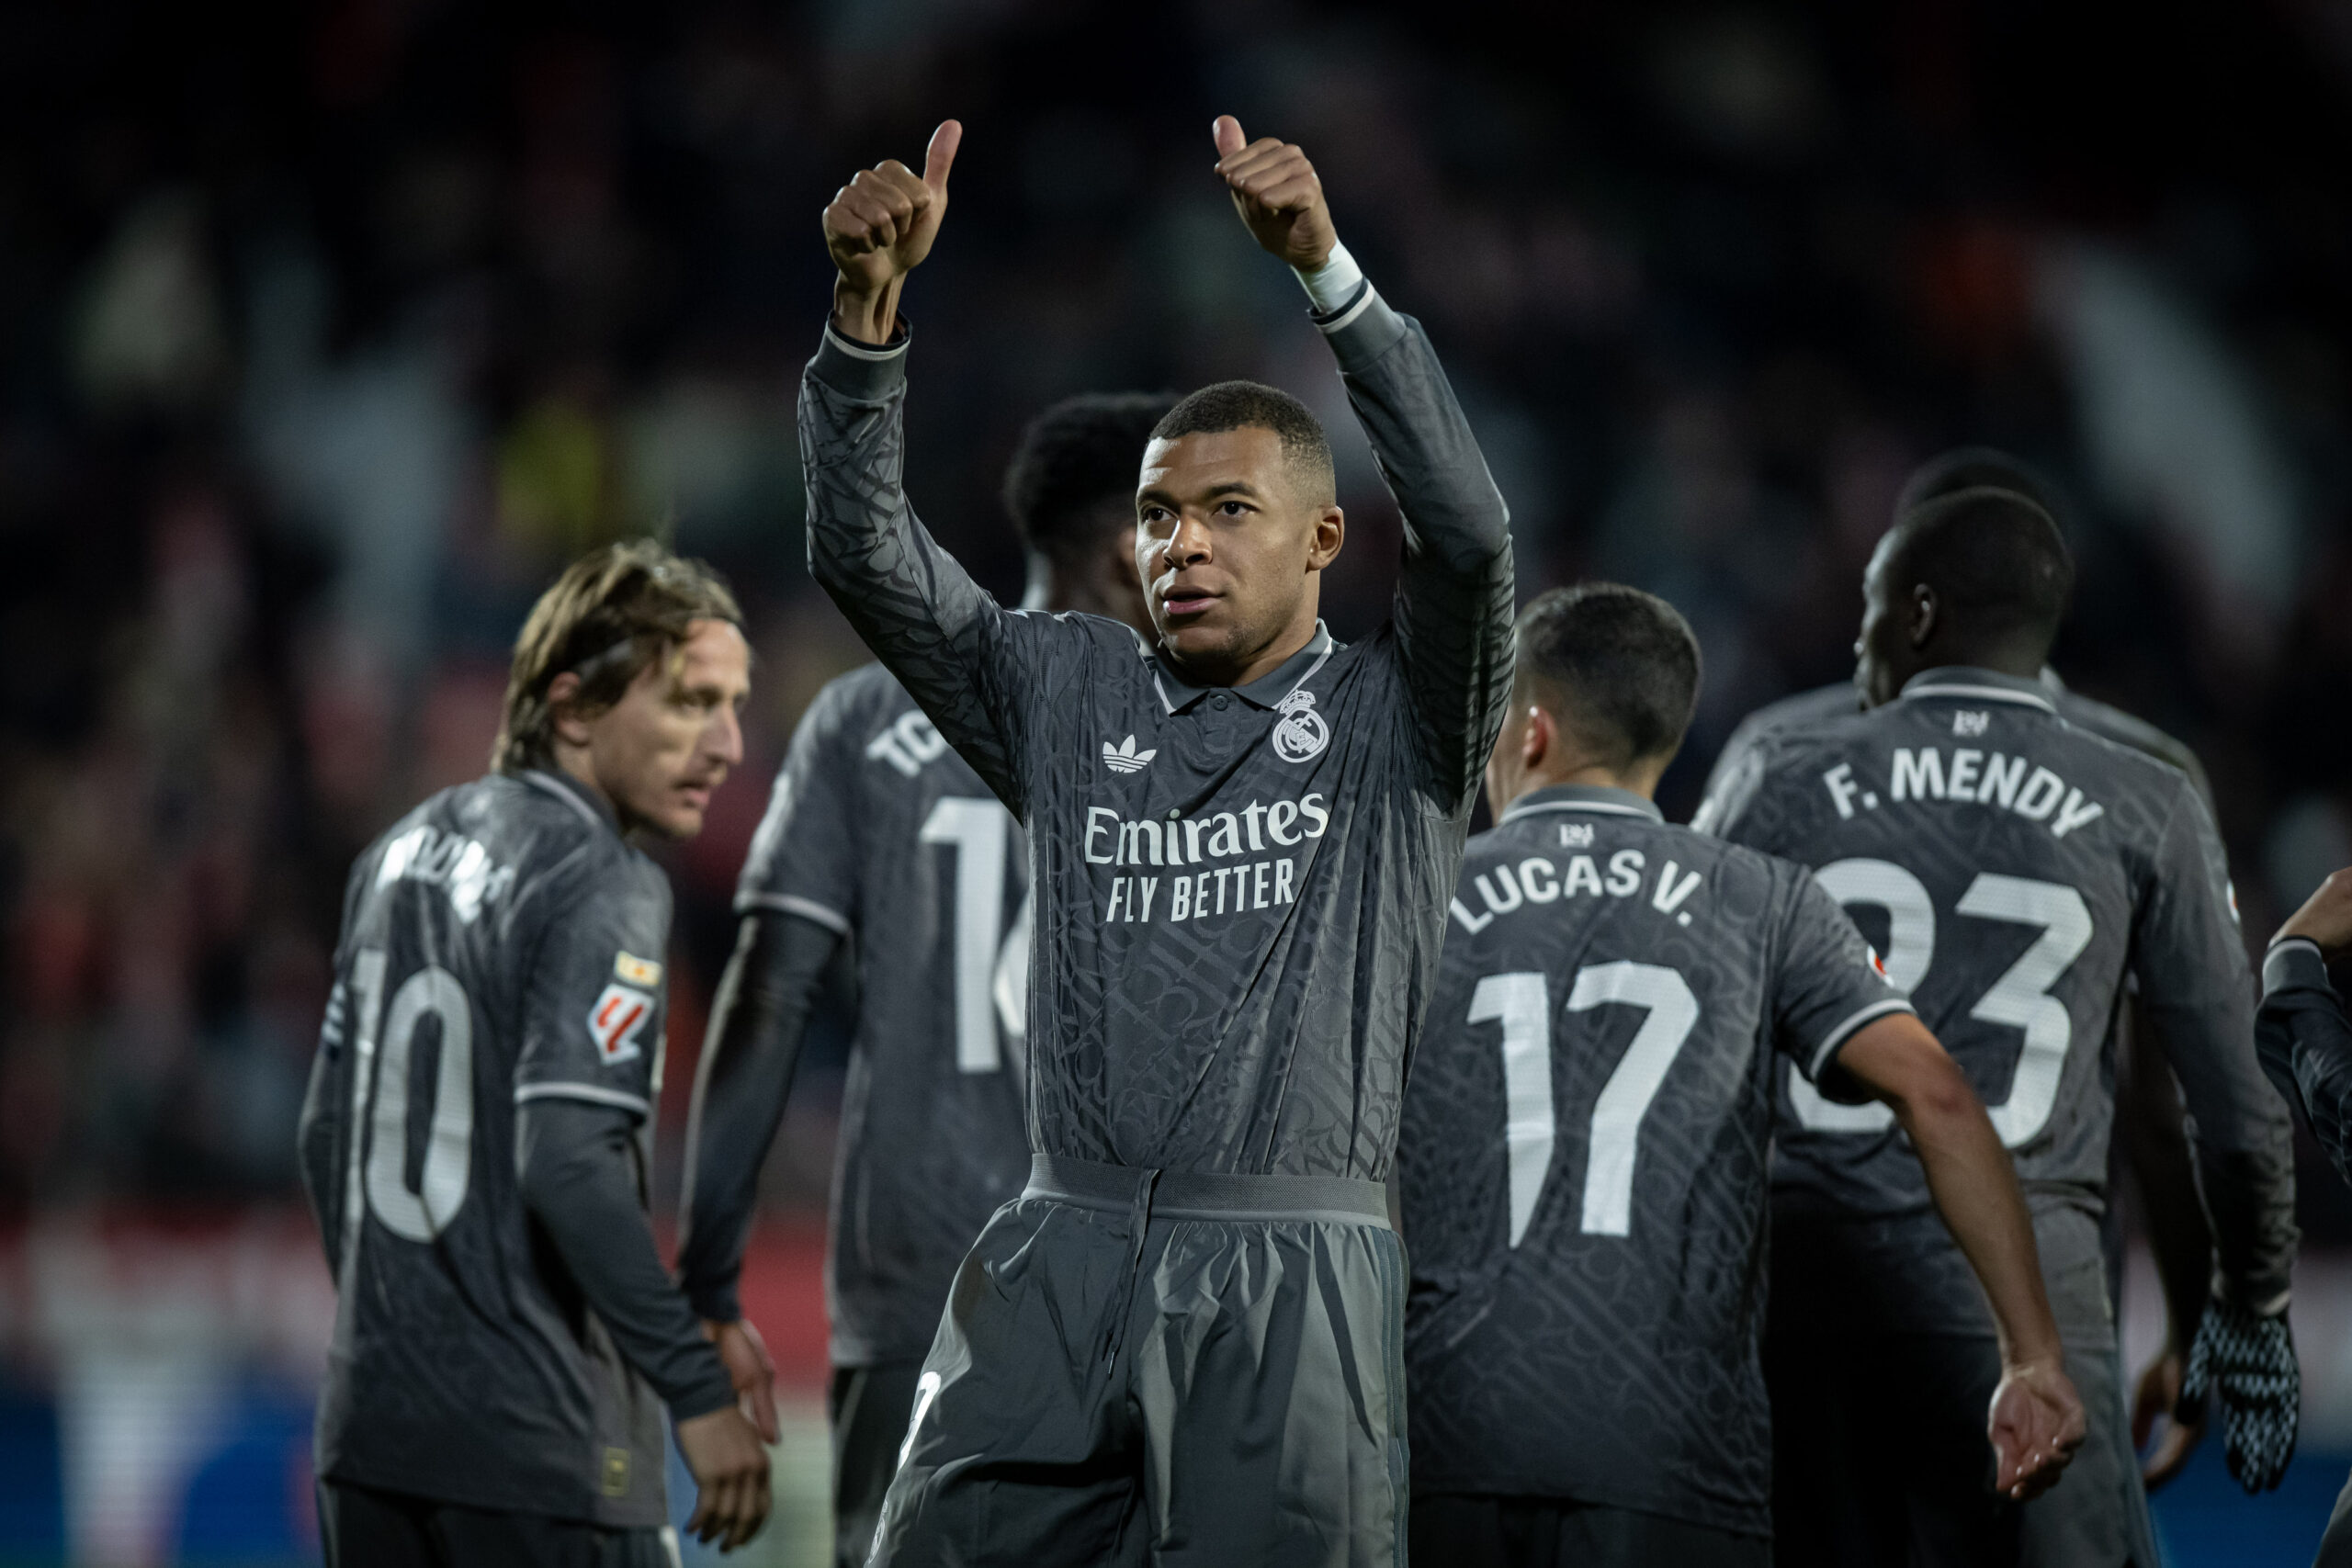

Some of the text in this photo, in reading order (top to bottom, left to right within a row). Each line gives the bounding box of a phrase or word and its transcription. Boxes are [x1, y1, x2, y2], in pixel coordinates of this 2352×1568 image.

[1084, 793, 1329, 866] Emirates
[1823, 747, 2104, 838] F. MENDY
[1106, 858, 1295, 923] FLY BETTER
[1451, 849, 1702, 935] LUCAS V.
[346, 948, 474, 1244] 10
[1466, 960, 1700, 1249] 17
